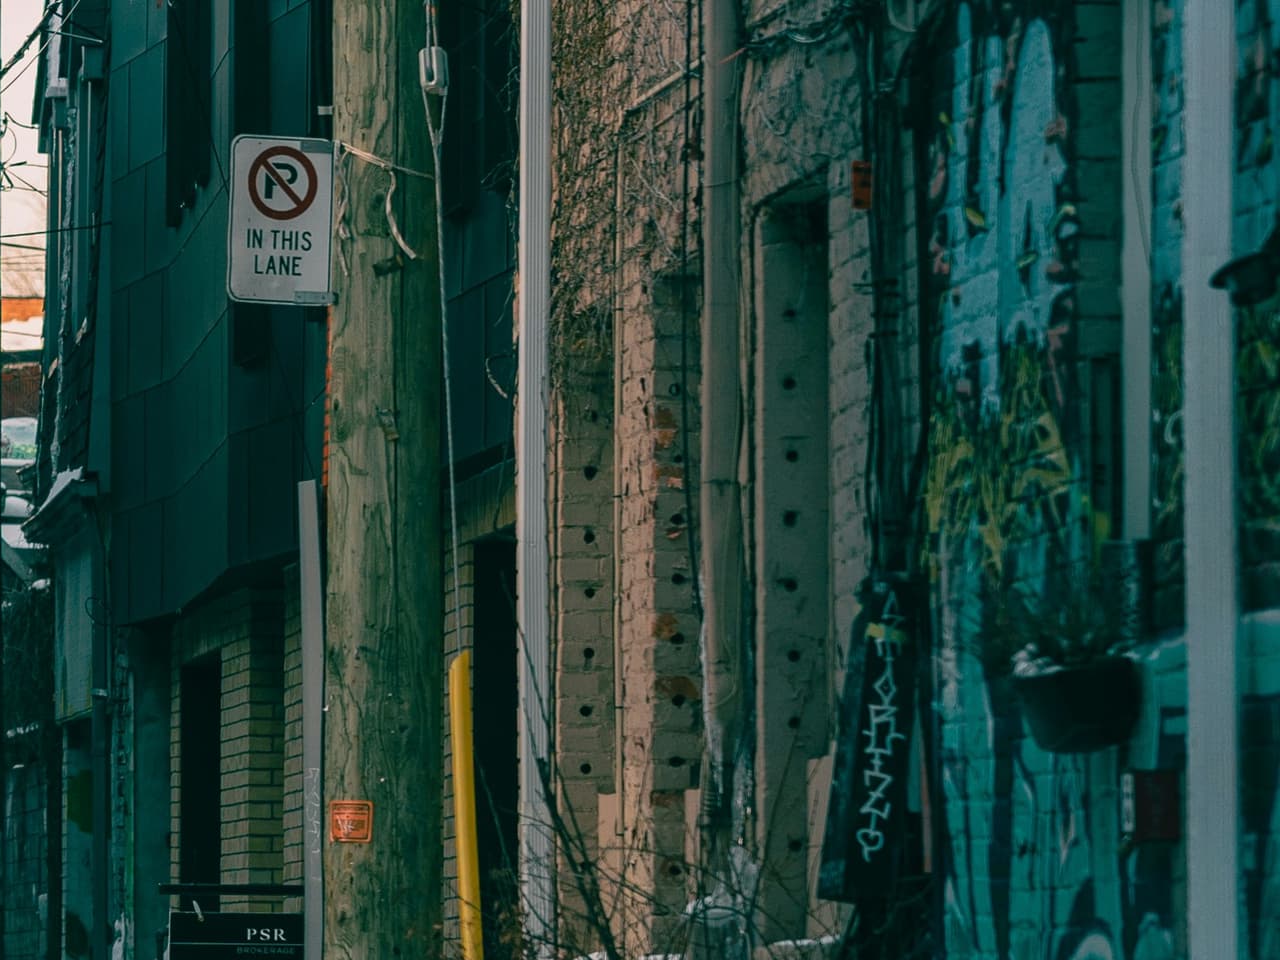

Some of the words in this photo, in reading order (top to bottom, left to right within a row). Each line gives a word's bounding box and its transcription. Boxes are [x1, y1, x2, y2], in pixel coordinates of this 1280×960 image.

[247, 228, 263, 249] IN
[271, 230, 312, 251] THIS
[254, 255, 302, 276] LANE
[246, 928, 287, 942] PSR
